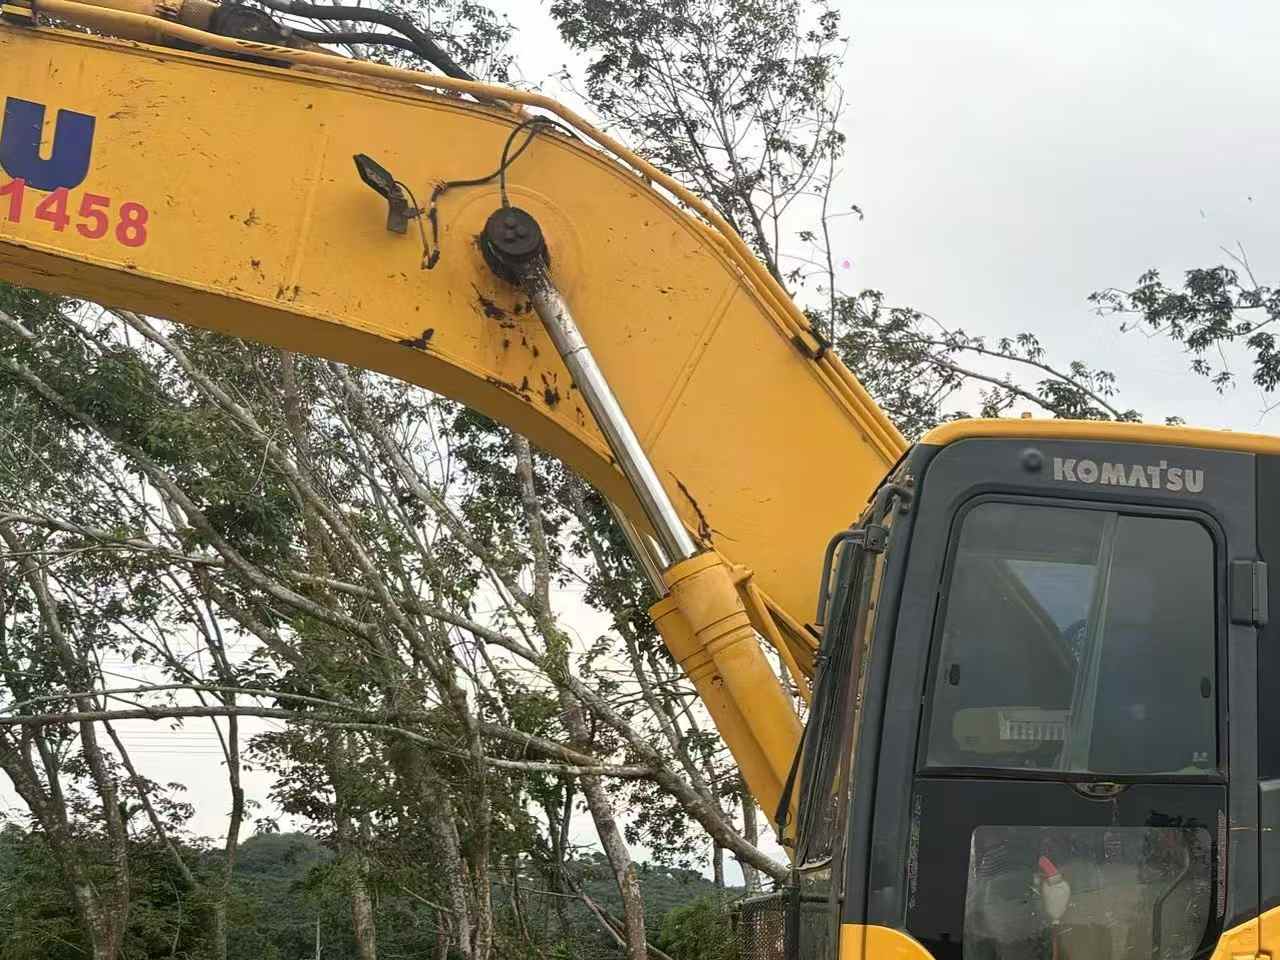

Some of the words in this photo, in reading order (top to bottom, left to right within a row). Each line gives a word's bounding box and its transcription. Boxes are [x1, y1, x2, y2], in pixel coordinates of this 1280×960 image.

[0, 96, 96, 192] U
[0, 177, 149, 247] 1458
[1053, 457, 1205, 493] KOMATSU
